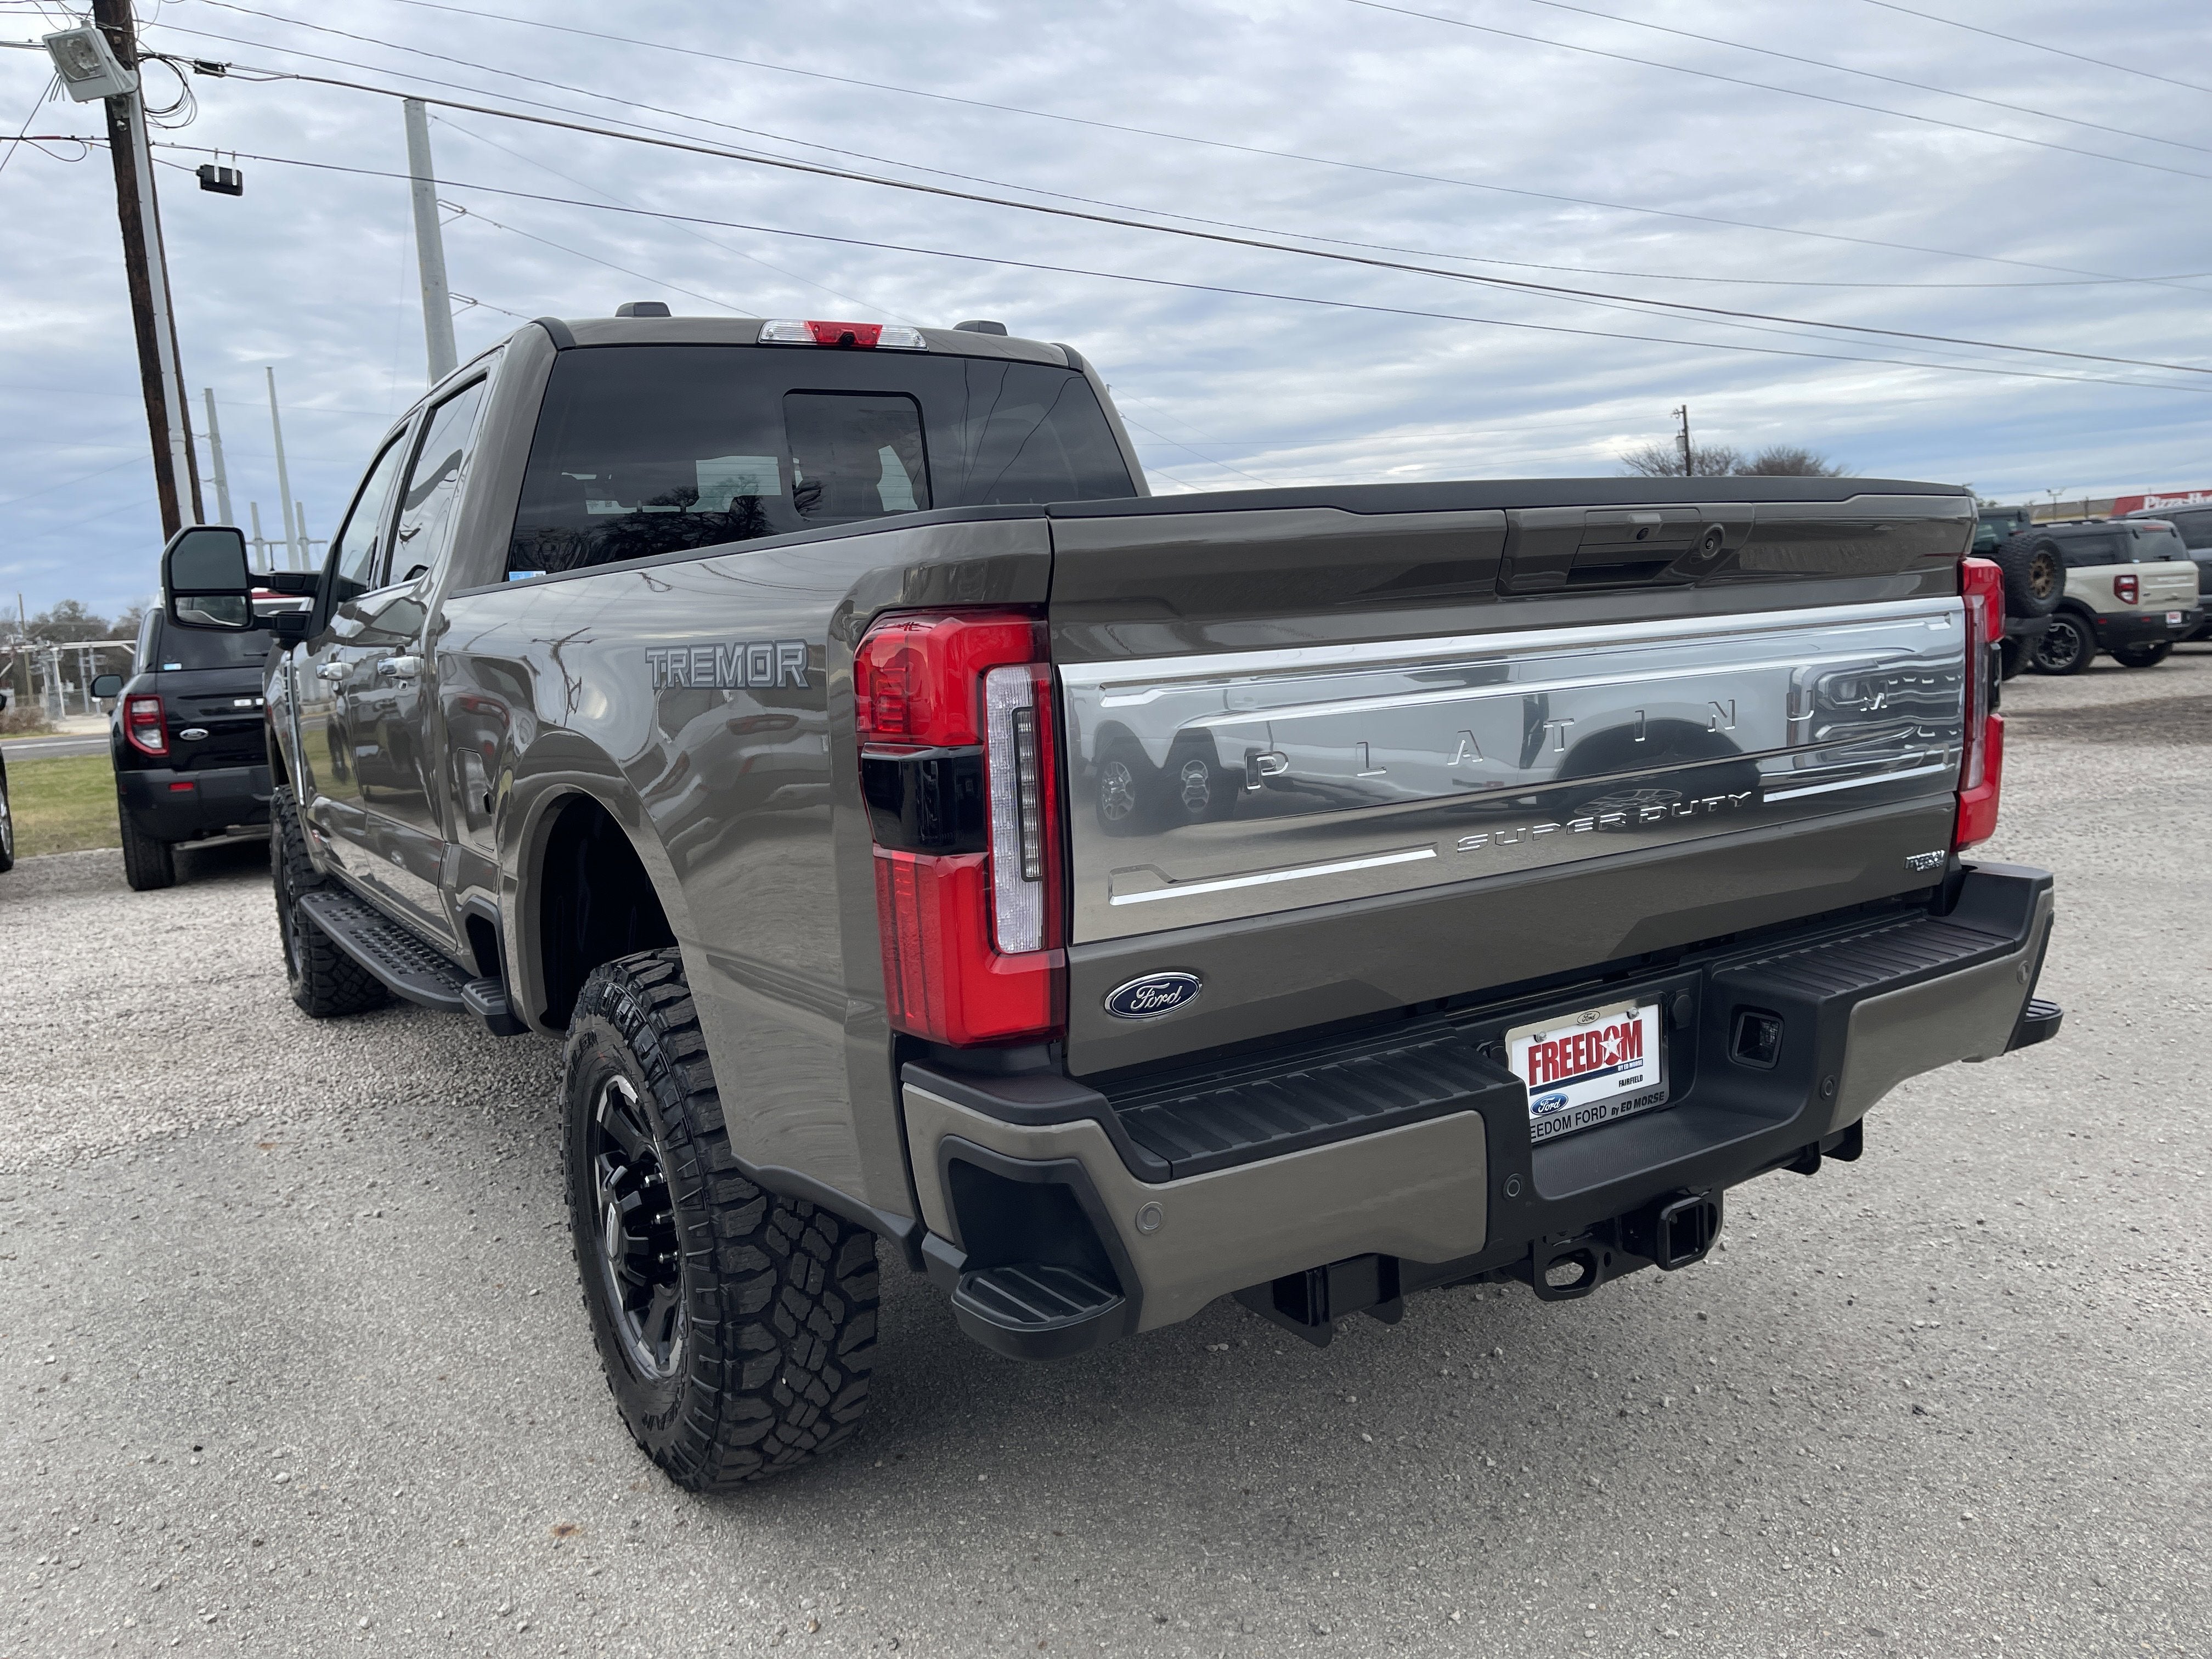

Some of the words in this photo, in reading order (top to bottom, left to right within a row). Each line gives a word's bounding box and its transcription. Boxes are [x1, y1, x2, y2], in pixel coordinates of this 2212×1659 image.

[2143, 495, 2184, 510] Pizza
[645, 639, 812, 690] TREMOR
[1244, 679, 1889, 790] PLATINUM
[1457, 812, 1627, 853] SUPER
[1639, 791, 1752, 823] DUTY
[1528, 1019, 1643, 1086] FREEDOM
[1618, 1074, 1643, 1088] FAIRFIELD
[1530, 1115, 1572, 1139] EEDOM
[1575, 1105, 1607, 1126] FORD
[1621, 1102, 1632, 1113] ED
[1633, 1091, 1664, 1109] MORSE
